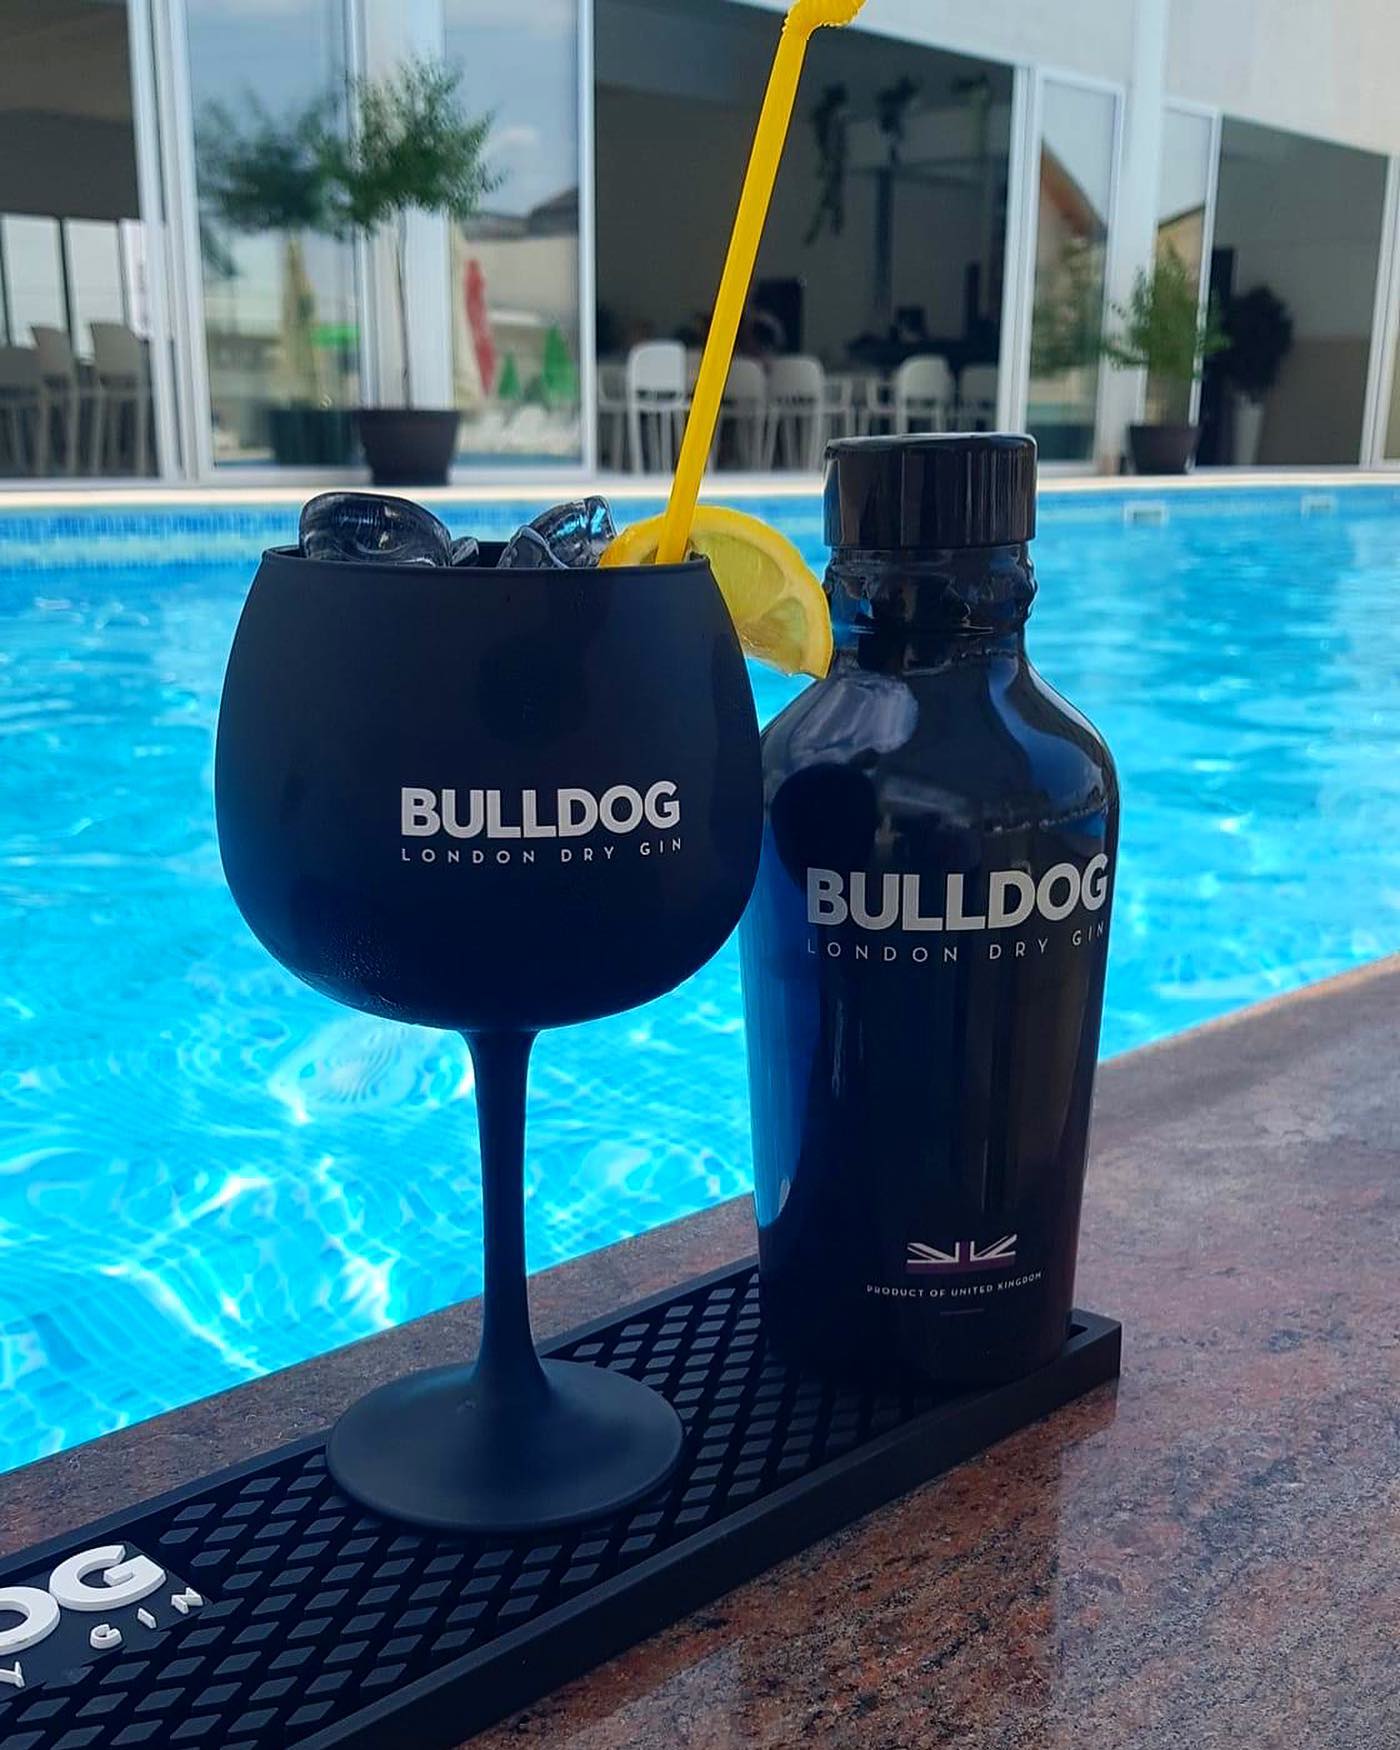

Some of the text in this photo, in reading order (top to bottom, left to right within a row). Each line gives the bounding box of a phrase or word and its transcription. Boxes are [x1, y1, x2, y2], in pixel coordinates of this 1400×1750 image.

[401, 781, 681, 838] BULLDOG
[402, 837, 682, 863] LONDON DRY GIN
[807, 853, 1109, 931] BULLDOG
[808, 920, 1104, 962] LONDON DRY GIN
[866, 1271, 1042, 1298] PRODUCT OF UNITED KINGDOM
[89, 1586, 204, 1650] GIN
